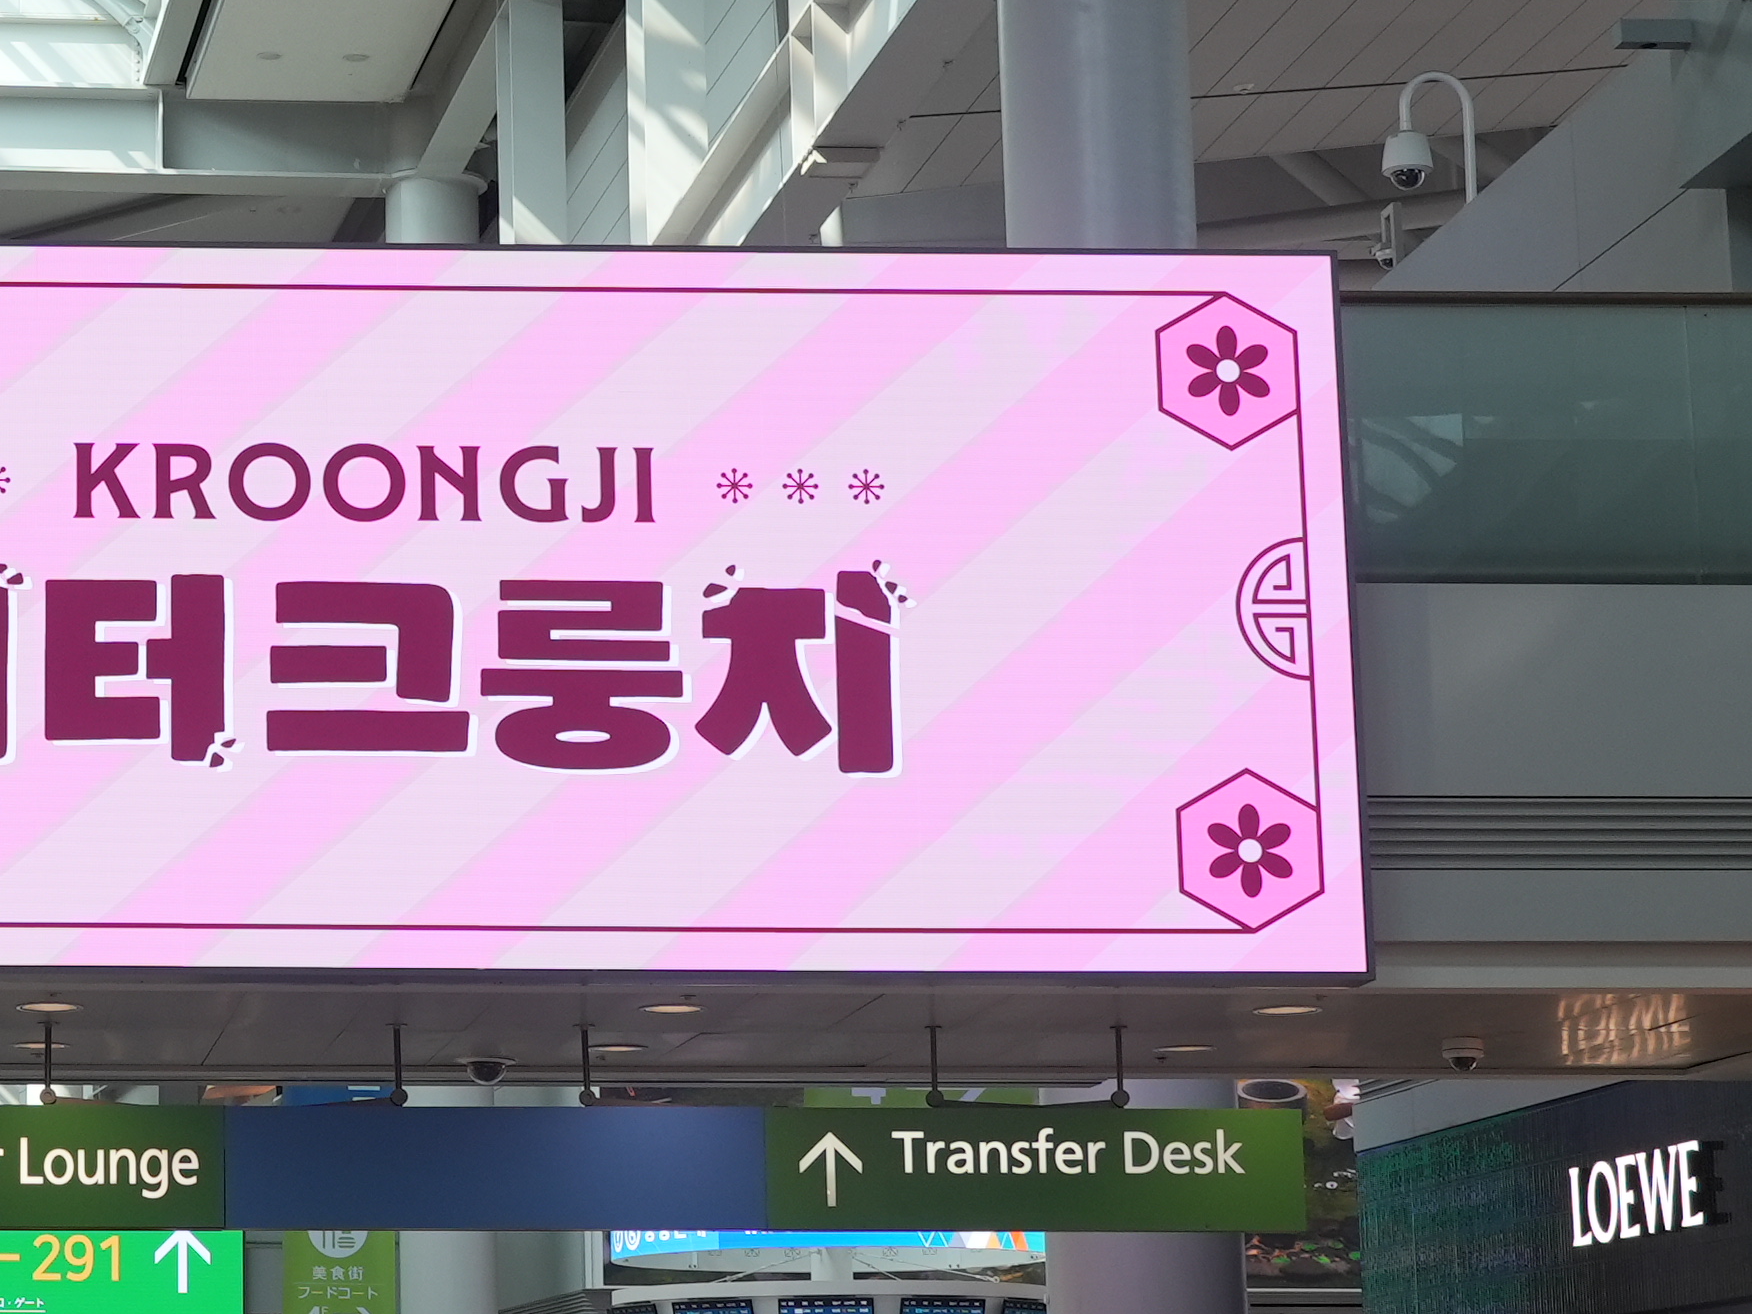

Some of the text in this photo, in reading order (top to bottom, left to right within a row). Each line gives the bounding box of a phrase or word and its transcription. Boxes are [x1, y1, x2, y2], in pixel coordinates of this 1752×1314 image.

[74, 443, 657, 527] KROONGJI
[18, 1135, 200, 1199] Lounge
[890, 1127, 1245, 1177] Transfer Desk
[1568, 1140, 1705, 1248] LOEWE
[32, 1233, 122, 1283] 291
[312, 1266, 364, 1281] 美食街
[14, 1296, 46, 1309] ゲート
[298, 1286, 378, 1300] フードコート
